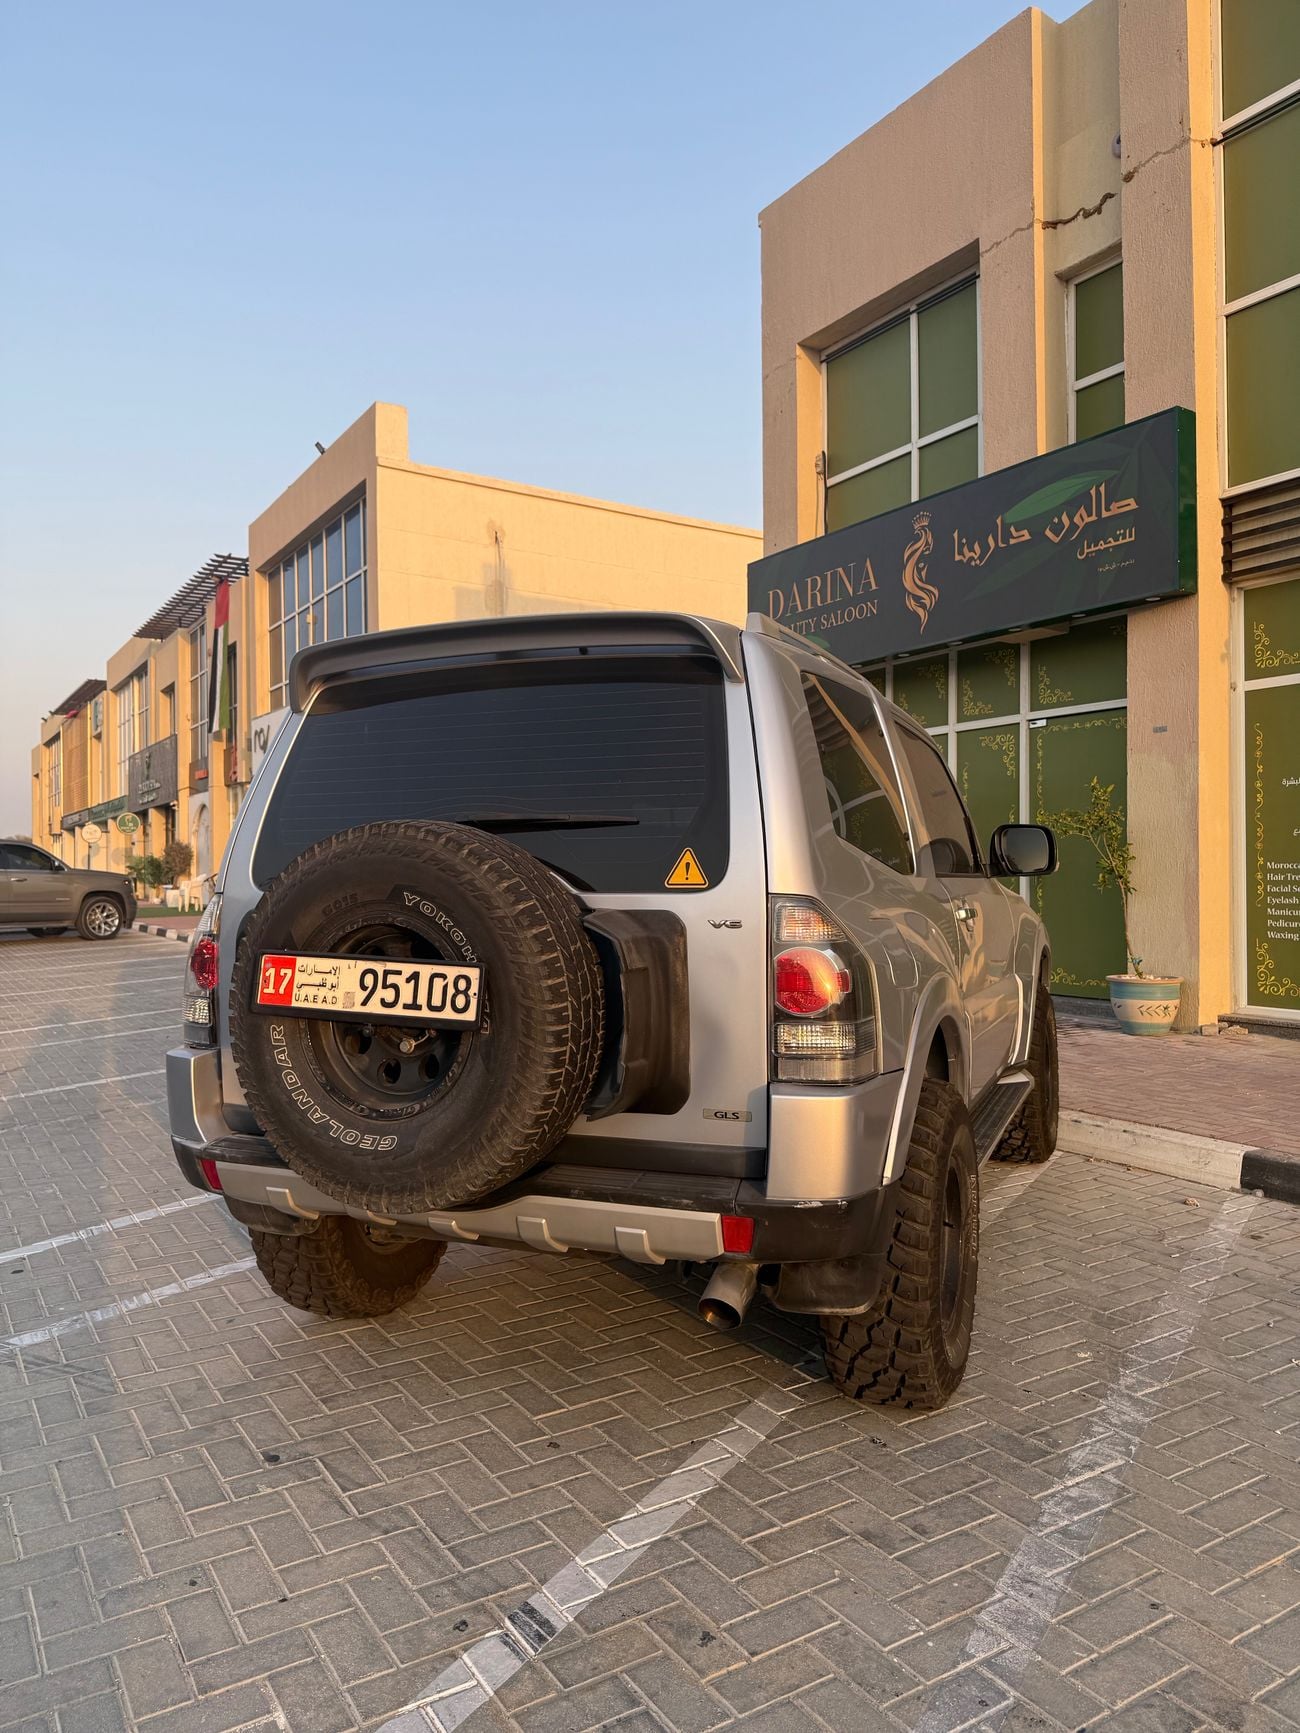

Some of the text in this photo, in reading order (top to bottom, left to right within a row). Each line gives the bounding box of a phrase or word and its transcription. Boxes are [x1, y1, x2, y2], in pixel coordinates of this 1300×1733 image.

[953, 481, 1139, 567] صالون دارينا
[1076, 526, 1136, 560] للتجميل
[767, 556, 880, 620] DARINA
[789, 599, 879, 636] UTY SALOON
[1266, 873, 1300, 881] Hair Tre
[1267, 884, 1291, 893] Facial
[1267, 896, 1299, 905] Eyelash
[707, 919, 743, 929] V6
[1267, 931, 1300, 941] Waxing
[262, 966, 293, 995] 17
[358, 967, 473, 1015] 95108
[270, 1024, 398, 1151] GEOLANDAR
[713, 1110, 740, 1120] GLS
